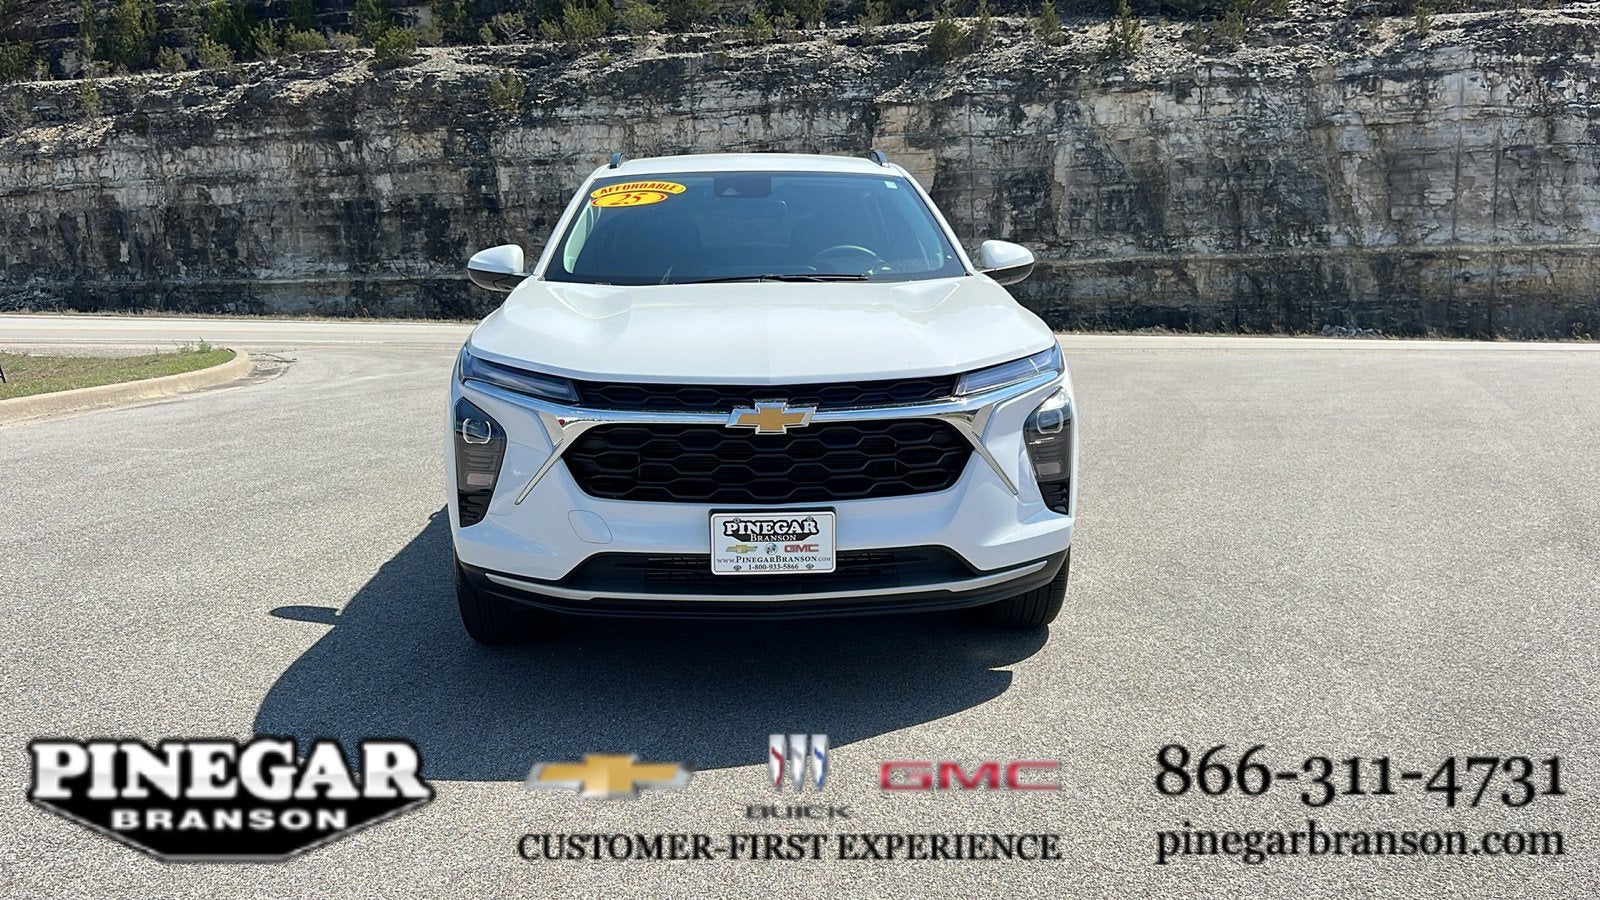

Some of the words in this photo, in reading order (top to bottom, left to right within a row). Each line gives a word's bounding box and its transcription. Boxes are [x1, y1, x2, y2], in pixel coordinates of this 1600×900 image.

[600, 183, 676, 194] AFFORDABLE
[608, 192, 649, 206] 25
[725, 521, 818, 535] PINEGAR
[784, 544, 819, 553] GMC
